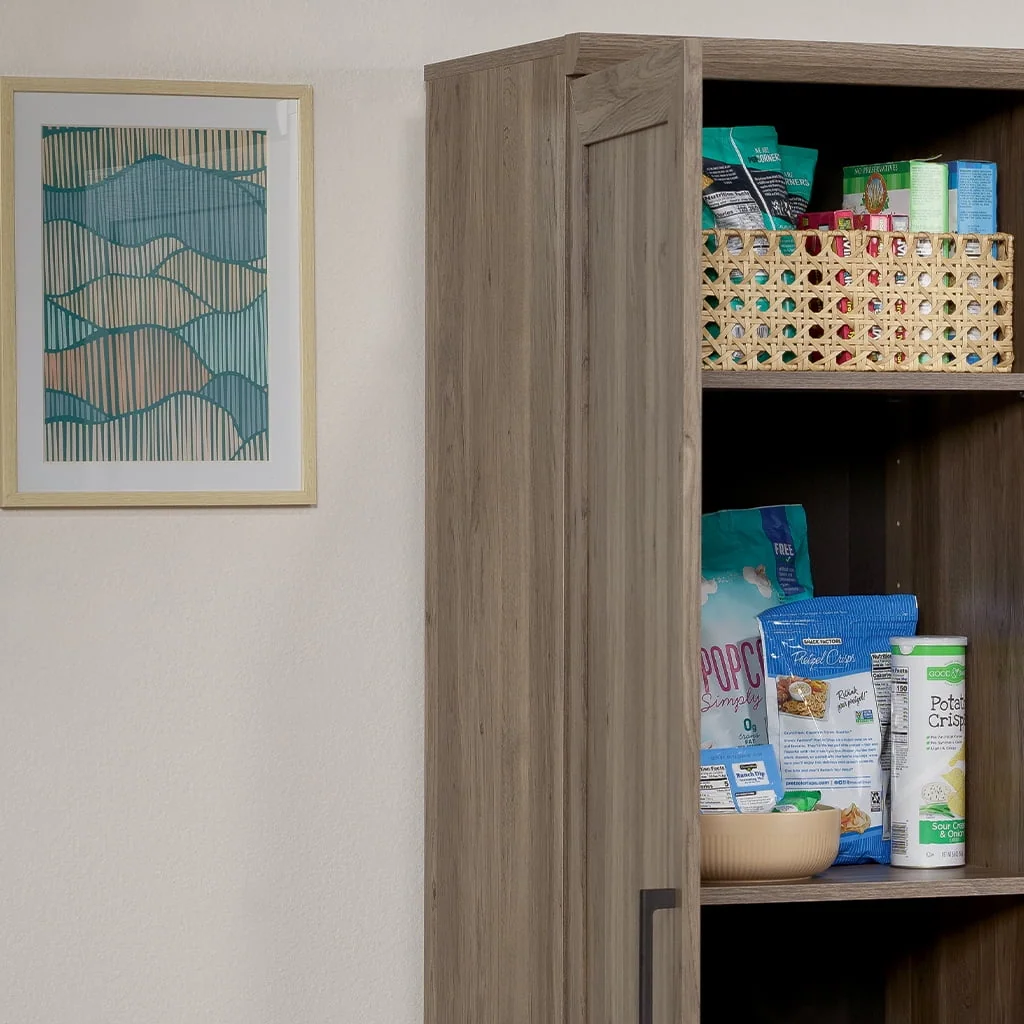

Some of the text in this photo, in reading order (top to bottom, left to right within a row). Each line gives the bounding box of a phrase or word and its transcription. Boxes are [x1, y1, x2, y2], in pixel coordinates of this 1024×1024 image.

[774, 542, 795, 556] FREE
[700, 638, 765, 693] POPC
[927, 670, 950, 678] GOOD
[700, 687, 763, 714] Simply
[930, 694, 966, 712] Potat
[743, 718, 757, 732] 0g
[928, 713, 966, 732] Crisp
[735, 770, 765, 779] Ranch Dip
[932, 822, 951, 830] Sour
[940, 830, 946, 839] &
